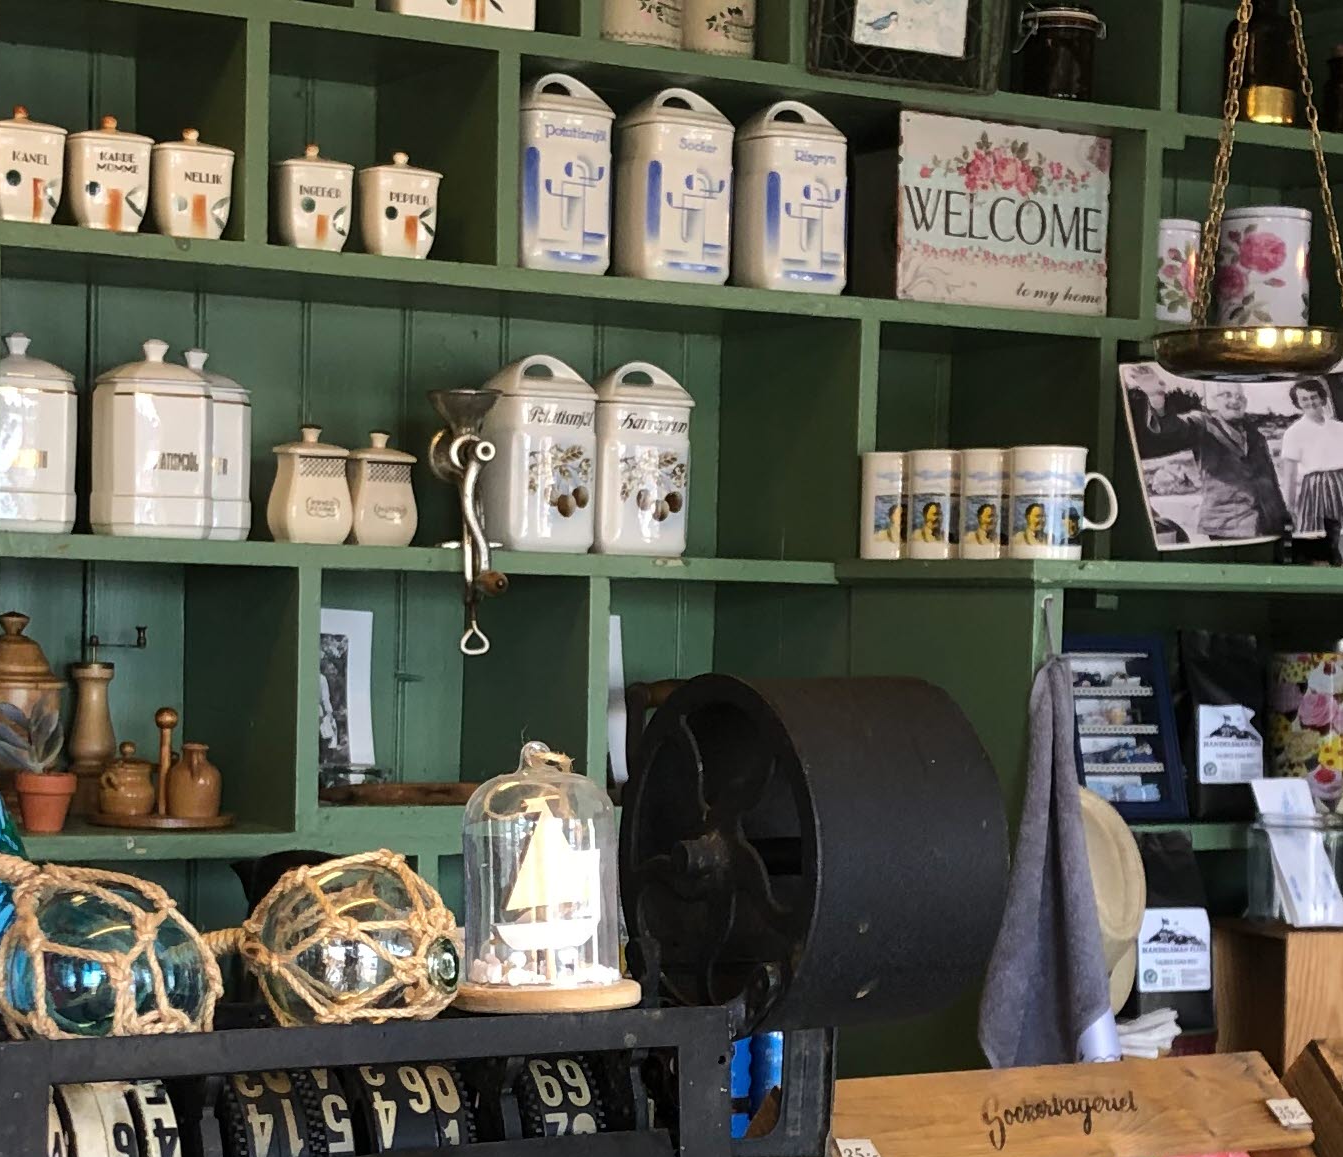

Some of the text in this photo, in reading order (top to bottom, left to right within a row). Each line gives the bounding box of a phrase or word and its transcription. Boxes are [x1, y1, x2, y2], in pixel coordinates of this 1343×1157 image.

[678, 137, 718, 154] Socker
[12, 150, 49, 166] KANEL
[794, 149, 837, 167] Risgryn
[184, 171, 223, 185] NELLIK
[389, 191, 430, 206] PEPPER
[904, 185, 1103, 254] WELCOME
[1017, 282, 1102, 307] to my home
